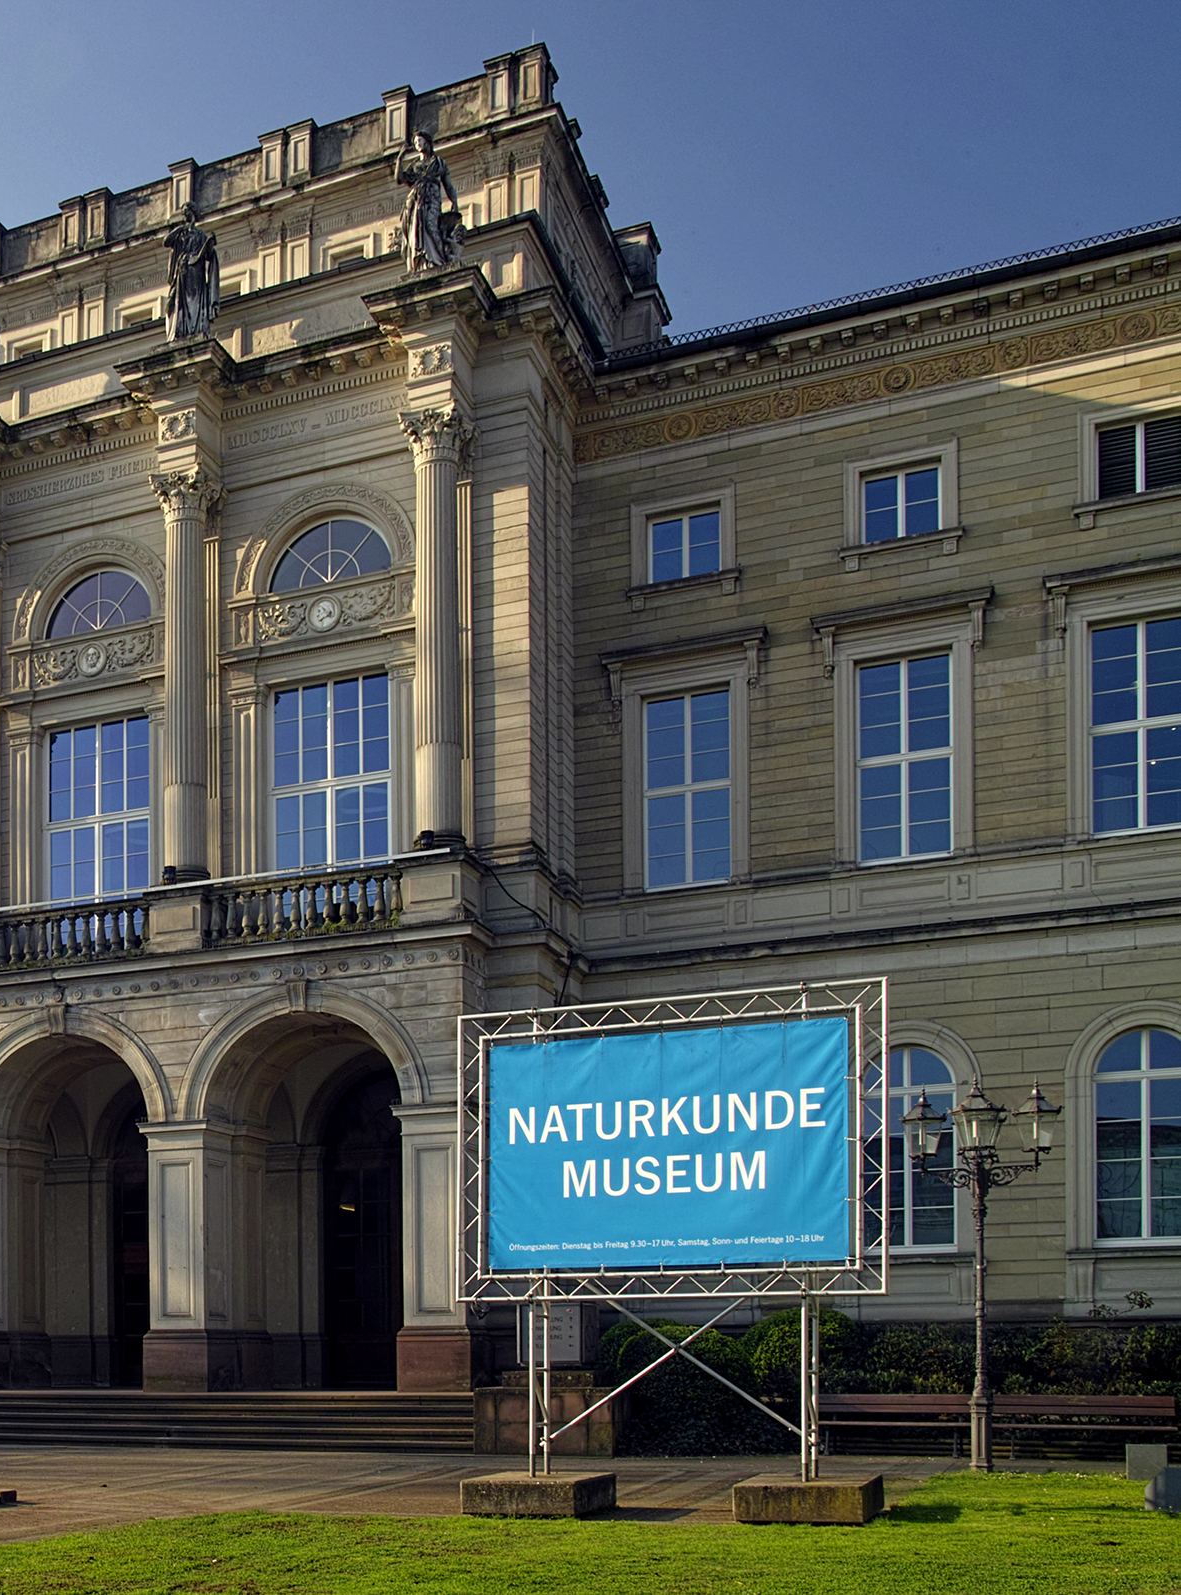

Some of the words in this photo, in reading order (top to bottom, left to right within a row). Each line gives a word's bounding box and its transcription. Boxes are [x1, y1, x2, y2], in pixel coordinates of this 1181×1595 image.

[228, 418, 308, 449] MDCCCLXV
[6, 469, 105, 506] GROSSHERZOGES
[509, 1087, 826, 1144] NATURKUNDE
[563, 1150, 765, 1198] MUSEUM
[509, 1243, 560, 1252] Öffnungszeiten:
[562, 1242, 592, 1250] Dienstag
[605, 1240, 629, 1249] Freitag
[678, 1238, 710, 1247] Samstag,
[712, 1237, 733, 1245] Sonn-
[750, 1236, 784, 1244] Feiertage
[811, 1234, 824, 1242] Uhr
